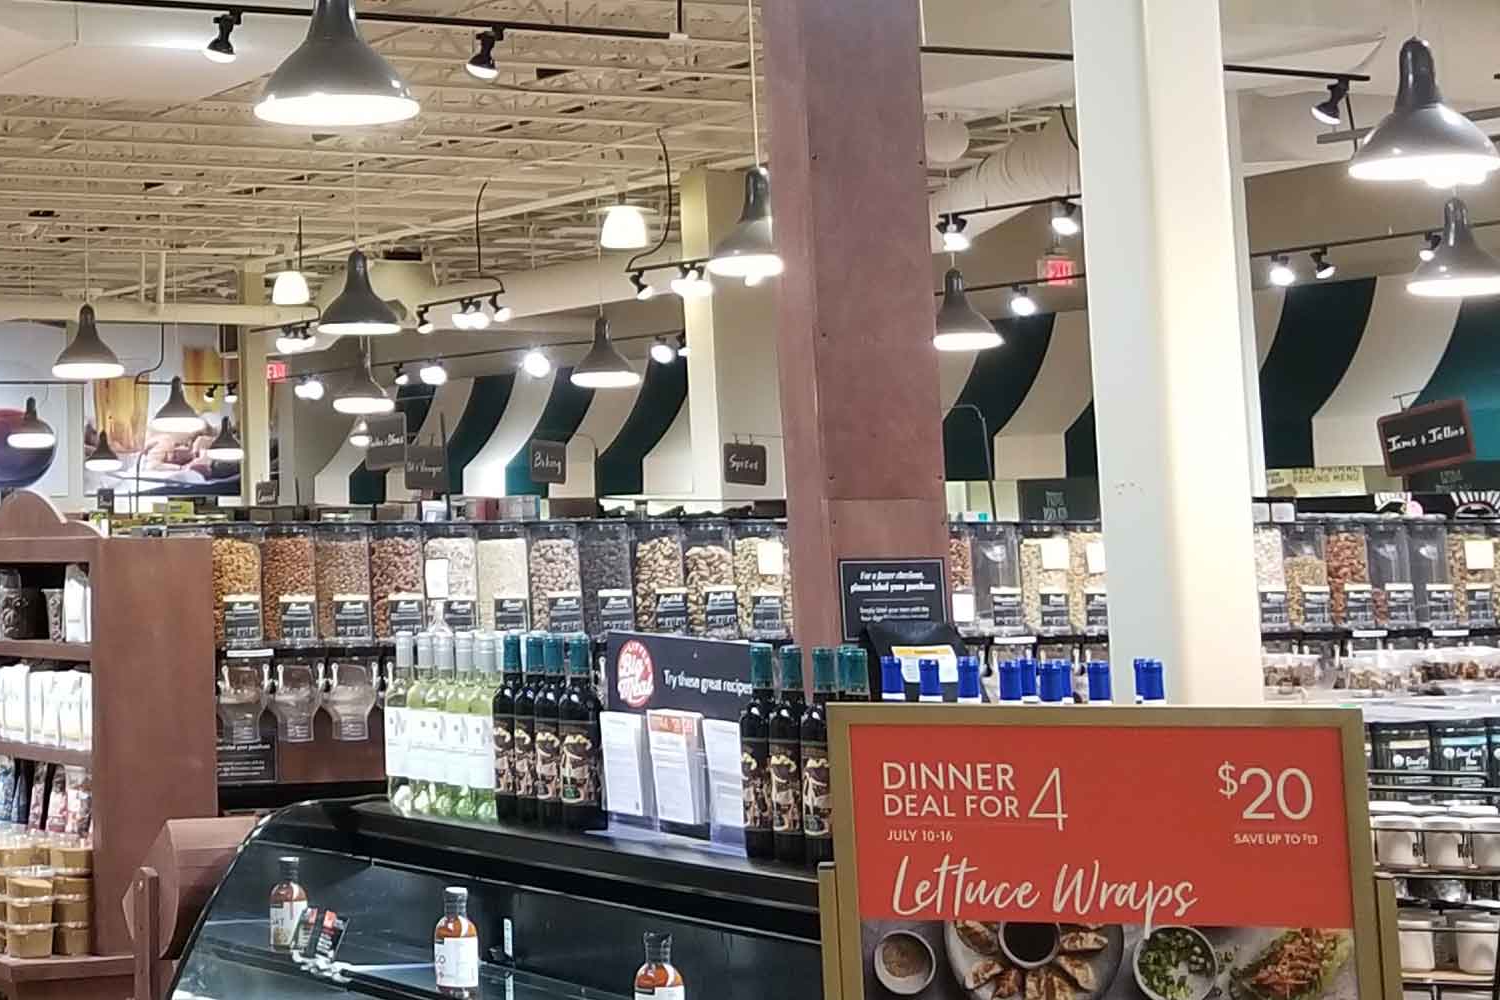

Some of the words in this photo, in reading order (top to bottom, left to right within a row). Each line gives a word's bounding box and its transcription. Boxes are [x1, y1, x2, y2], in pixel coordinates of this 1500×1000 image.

[664, 669, 678, 690] Try
[678, 670, 700, 688] these
[701, 678, 722, 695] great
[723, 679, 753, 697] recipes
[883, 762, 1015, 791] DINNER
[1218, 761, 1313, 820] $20
[884, 794, 956, 817] DEAL
[965, 795, 1020, 818] FOR
[1028, 767, 1069, 831] 4
[887, 829, 917, 841] JULY
[922, 830, 953, 842] 10-16
[1234, 833, 1265, 844] SAVE
[1266, 834, 1282, 844] UP
[1284, 833, 1301, 845] TO
[892, 854, 1041, 917] Lettuce
[1052, 859, 1198, 939] Wraps
